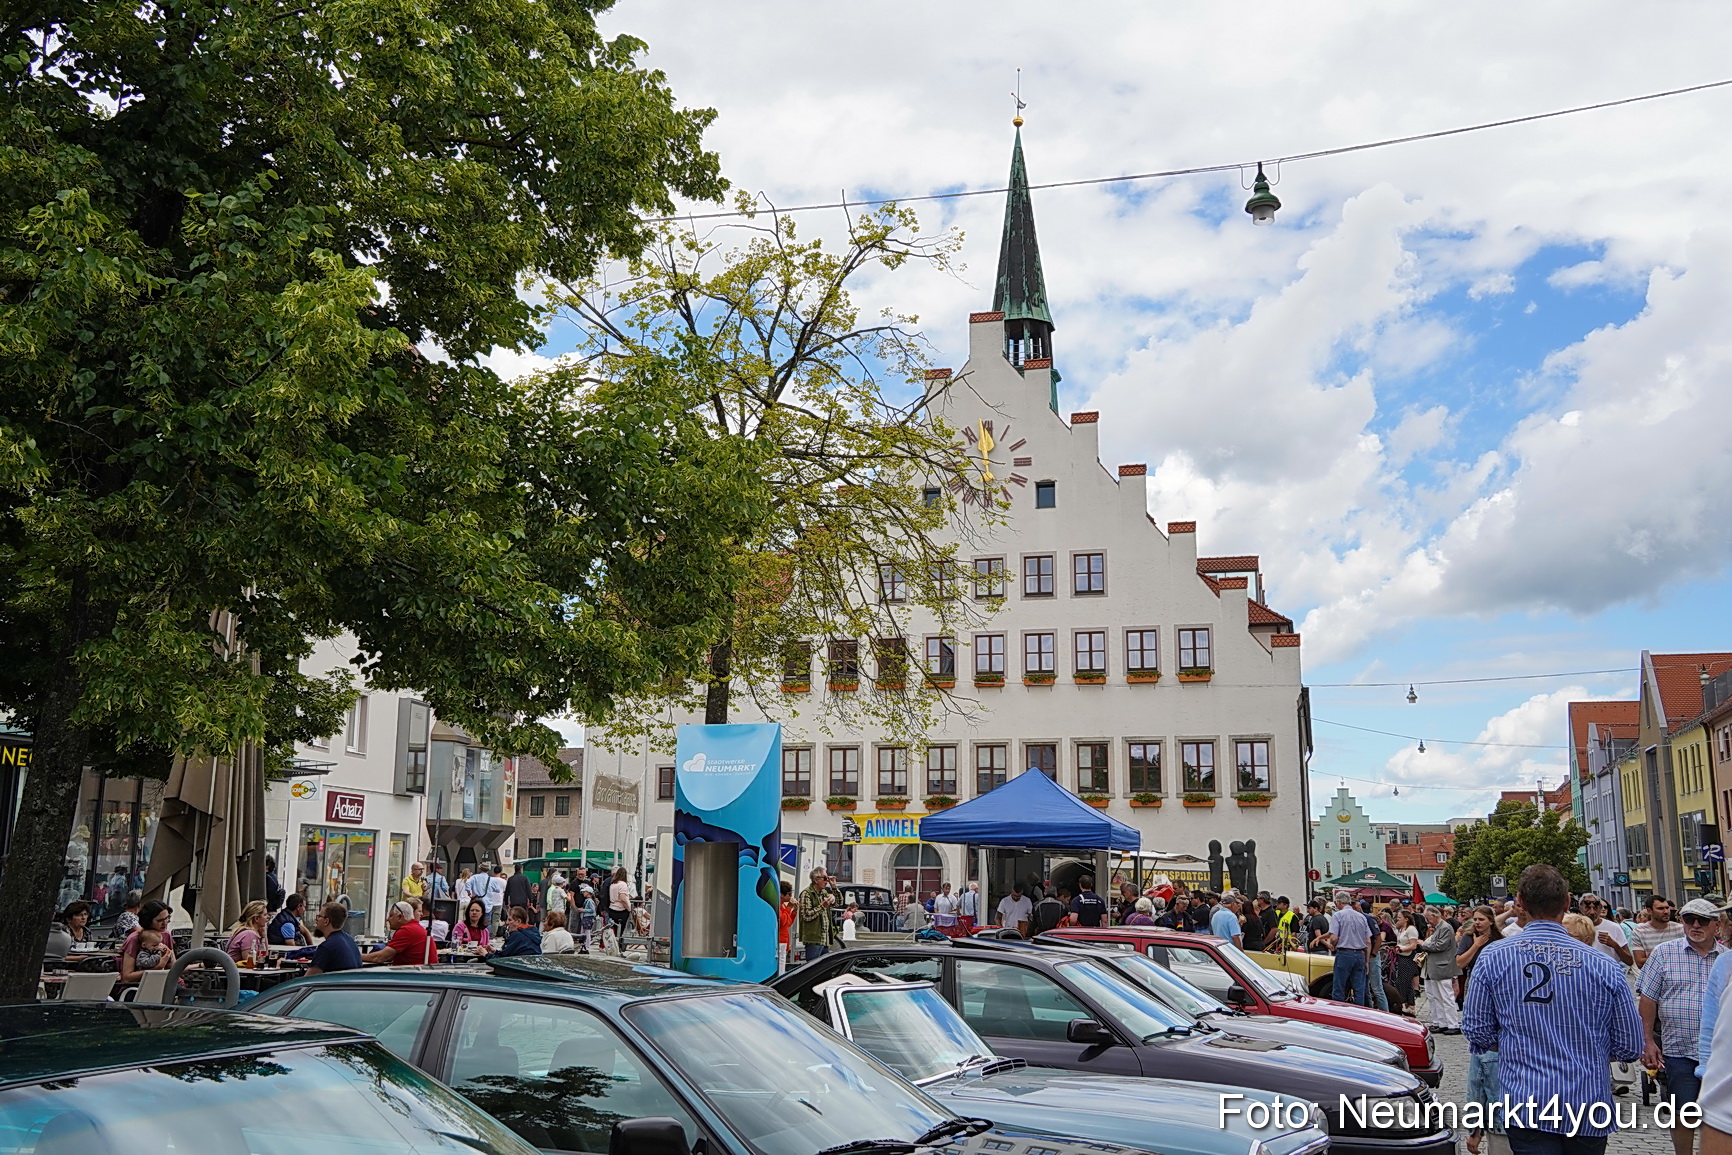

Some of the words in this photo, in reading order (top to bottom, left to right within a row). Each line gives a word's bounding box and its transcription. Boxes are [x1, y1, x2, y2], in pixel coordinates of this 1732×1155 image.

[705, 764, 756, 772] NEUMARKT
[332, 796, 363, 819] Achatz
[864, 818, 921, 839] ANMEL
[1523, 961, 1554, 1004] 2
